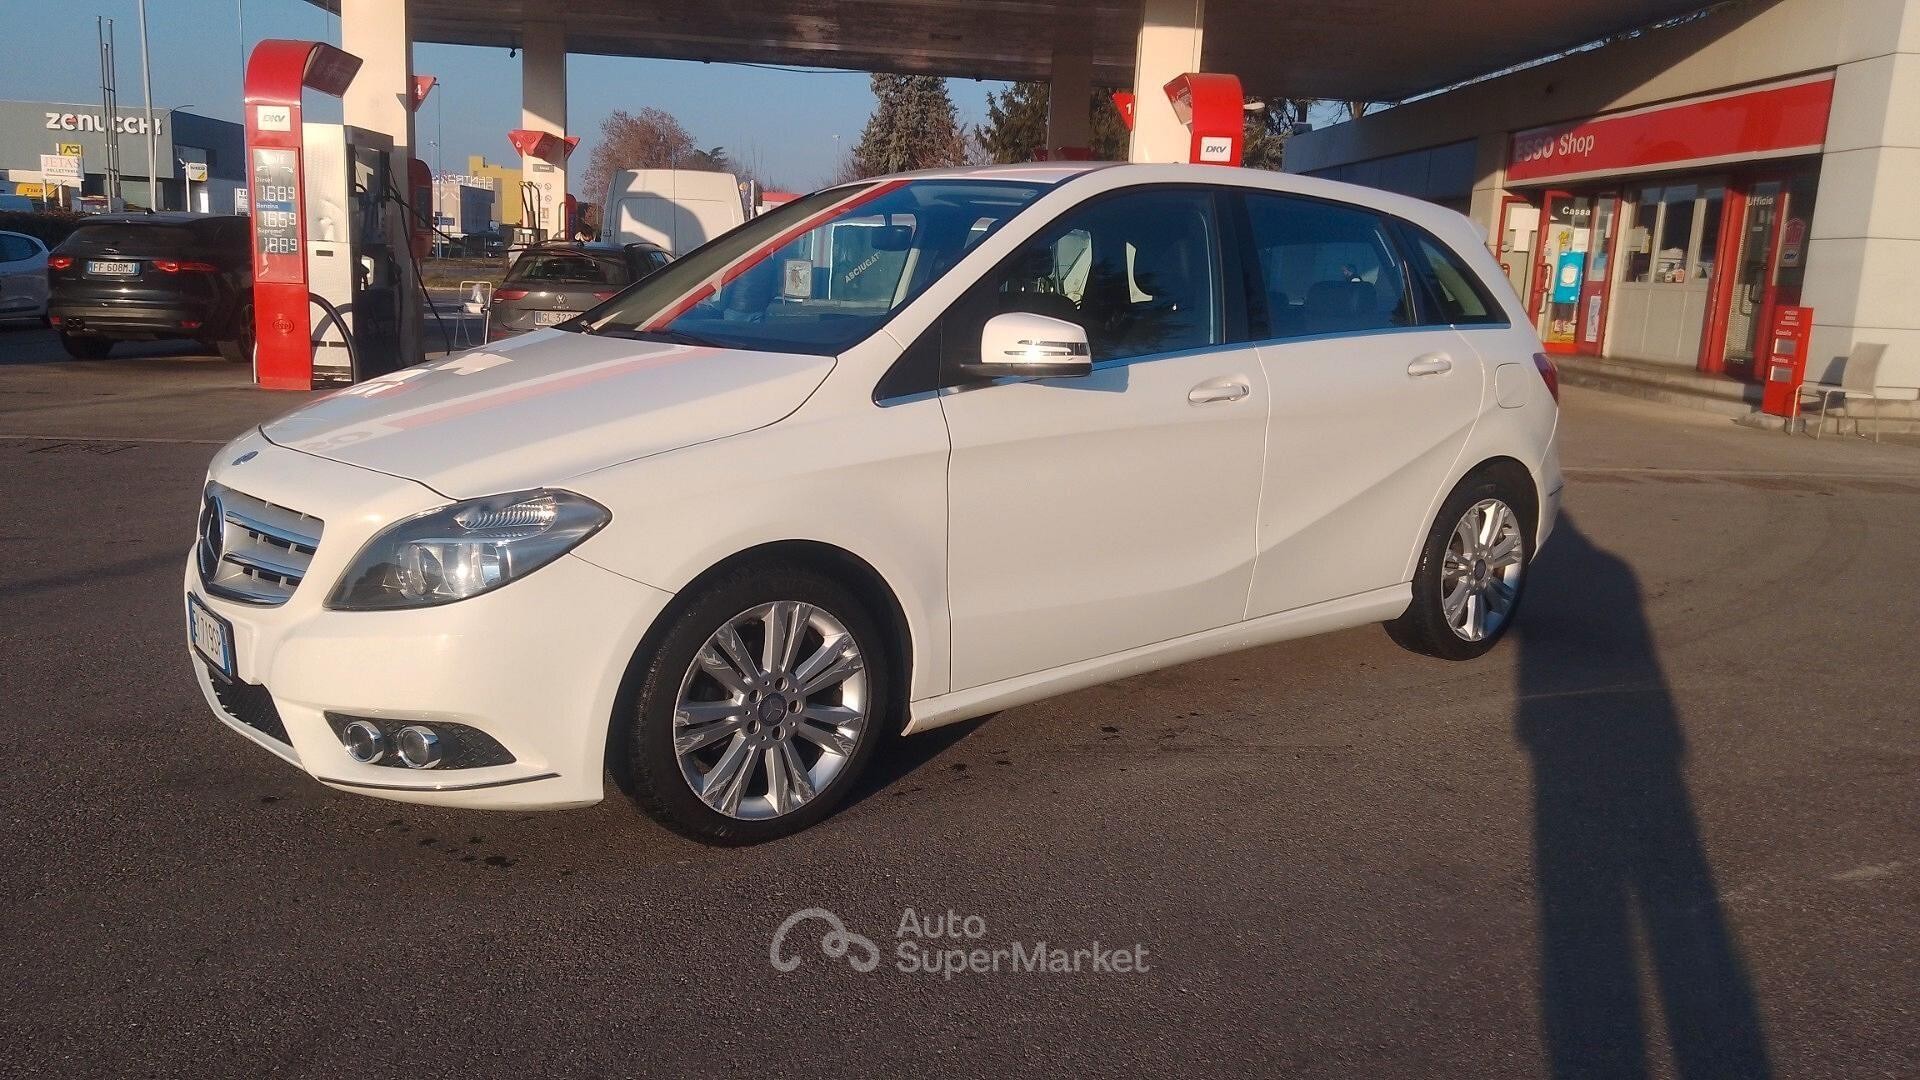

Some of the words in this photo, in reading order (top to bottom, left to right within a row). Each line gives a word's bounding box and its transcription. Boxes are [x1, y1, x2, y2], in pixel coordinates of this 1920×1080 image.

[1126, 103, 1132, 115] 1
[264, 114, 286, 122] DKV
[1206, 145, 1227, 153] DKV
[1558, 132, 1595, 157] Shop
[1747, 196, 1774, 206] Ufficio
[1561, 206, 1592, 216] Cassa
[93, 262, 103, 272] FF
[107, 263, 135, 273] 608MJ
